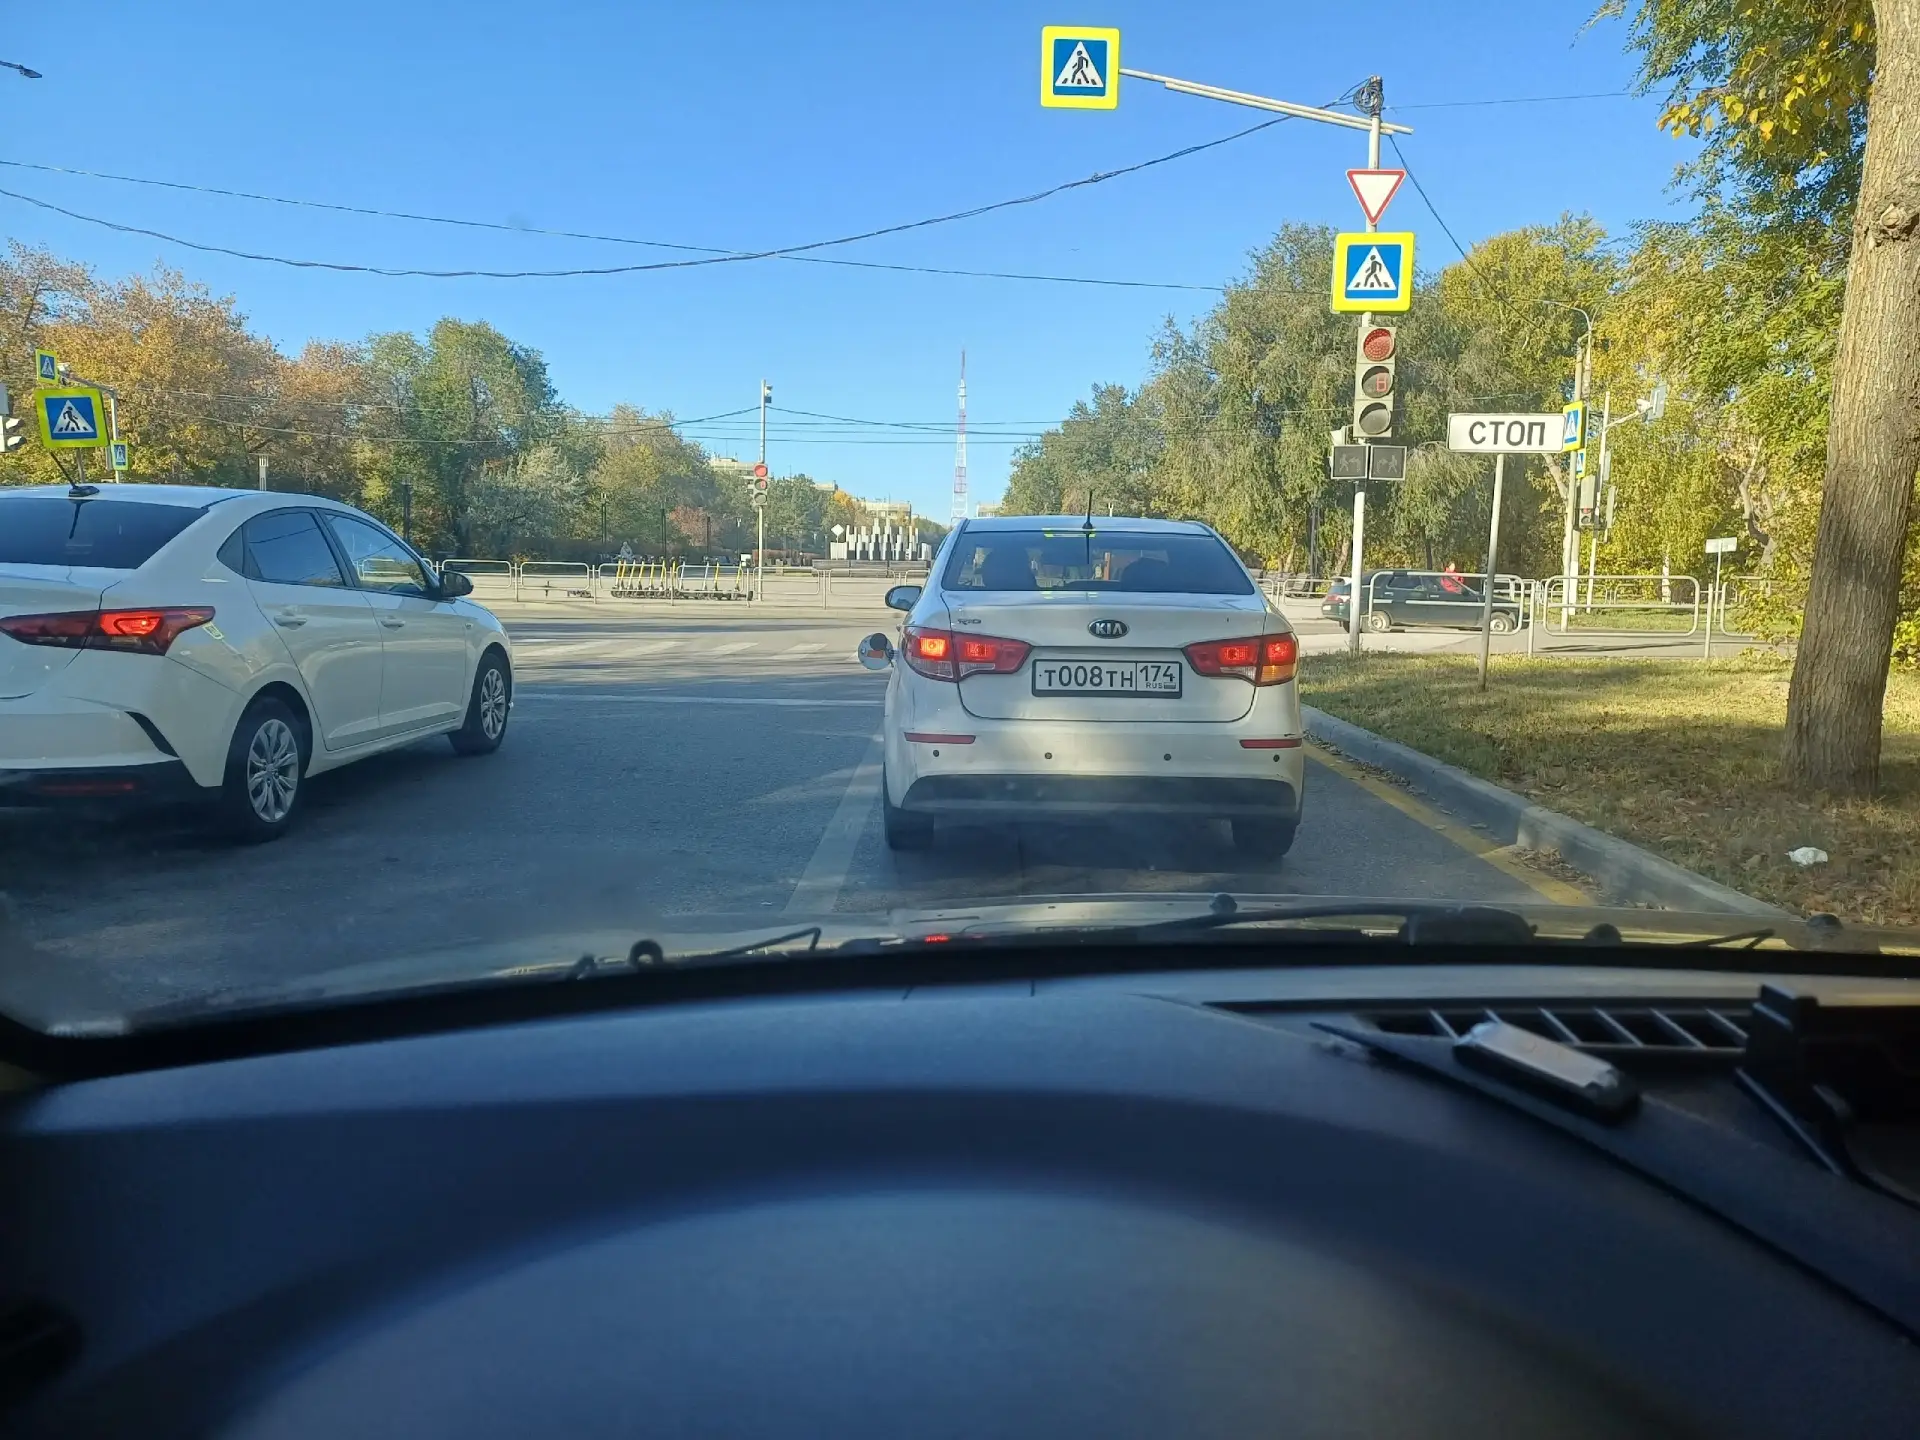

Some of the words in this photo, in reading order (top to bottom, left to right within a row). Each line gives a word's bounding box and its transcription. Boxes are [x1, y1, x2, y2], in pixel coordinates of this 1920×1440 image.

[1468, 420, 1545, 446] СТОП
[1095, 622, 1123, 635] KIA
[1139, 665, 1176, 682] 174
